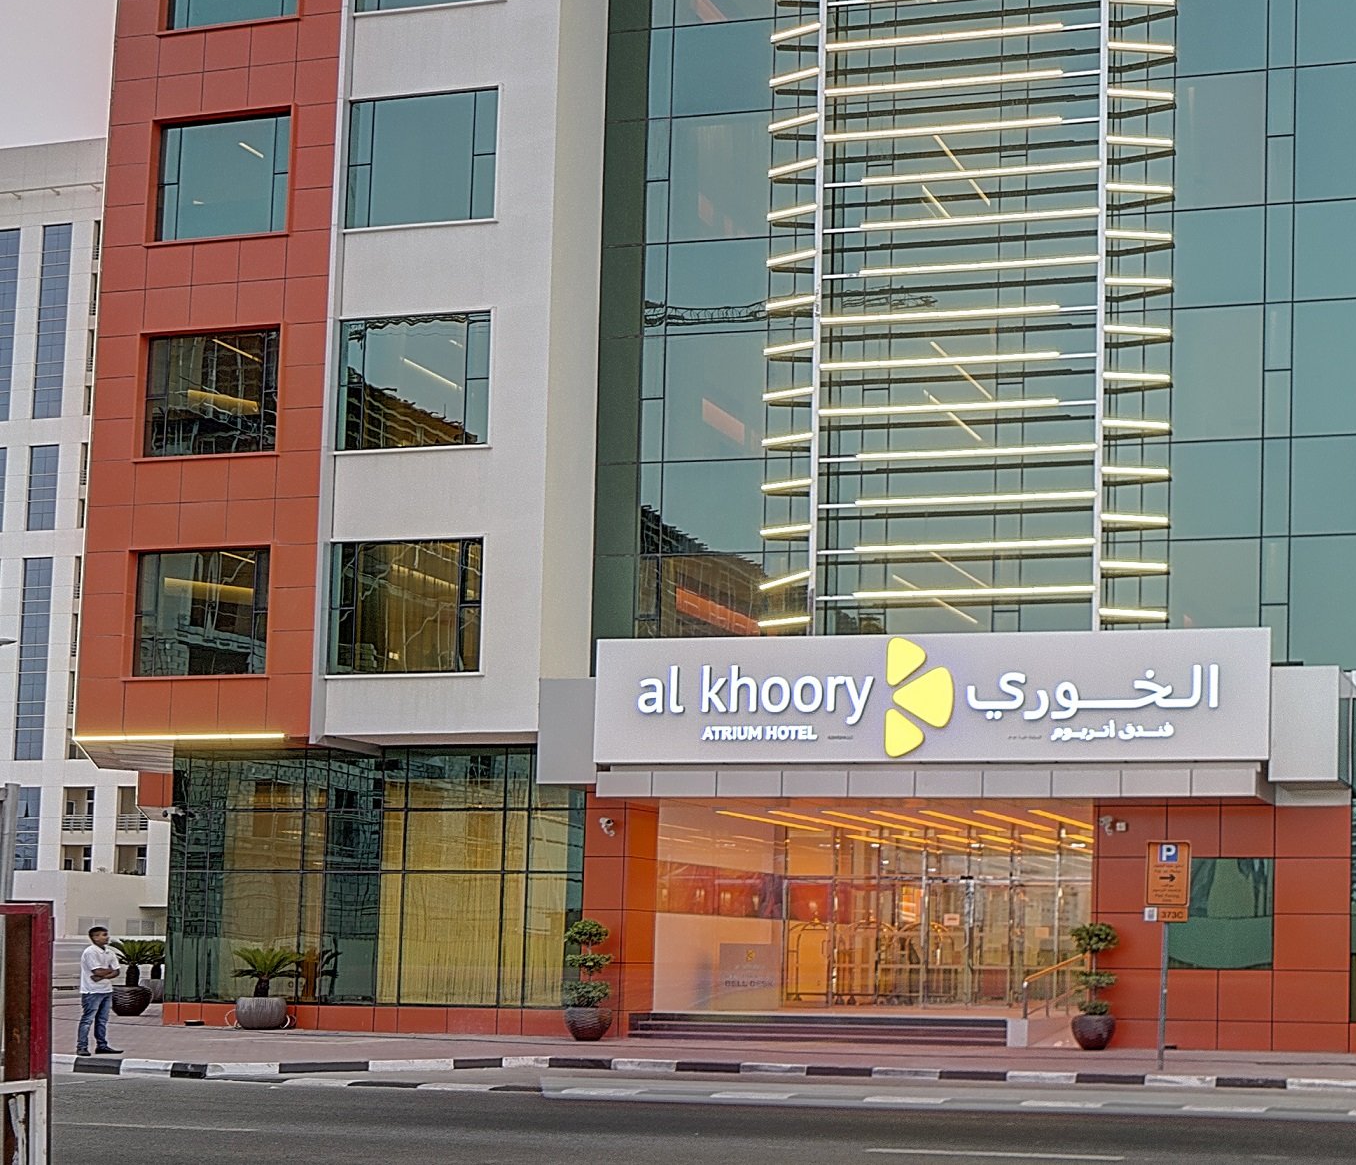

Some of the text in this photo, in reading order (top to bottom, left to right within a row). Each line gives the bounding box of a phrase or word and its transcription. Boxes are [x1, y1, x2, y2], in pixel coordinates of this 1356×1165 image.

[637, 664, 875, 725] al khoory
[966, 663, 1220, 721] الخوري
[701, 724, 818, 741] ATRIUM HOTEL
[1118, 721, 1175, 741] فندق
[1161, 844, 1176, 861] P
